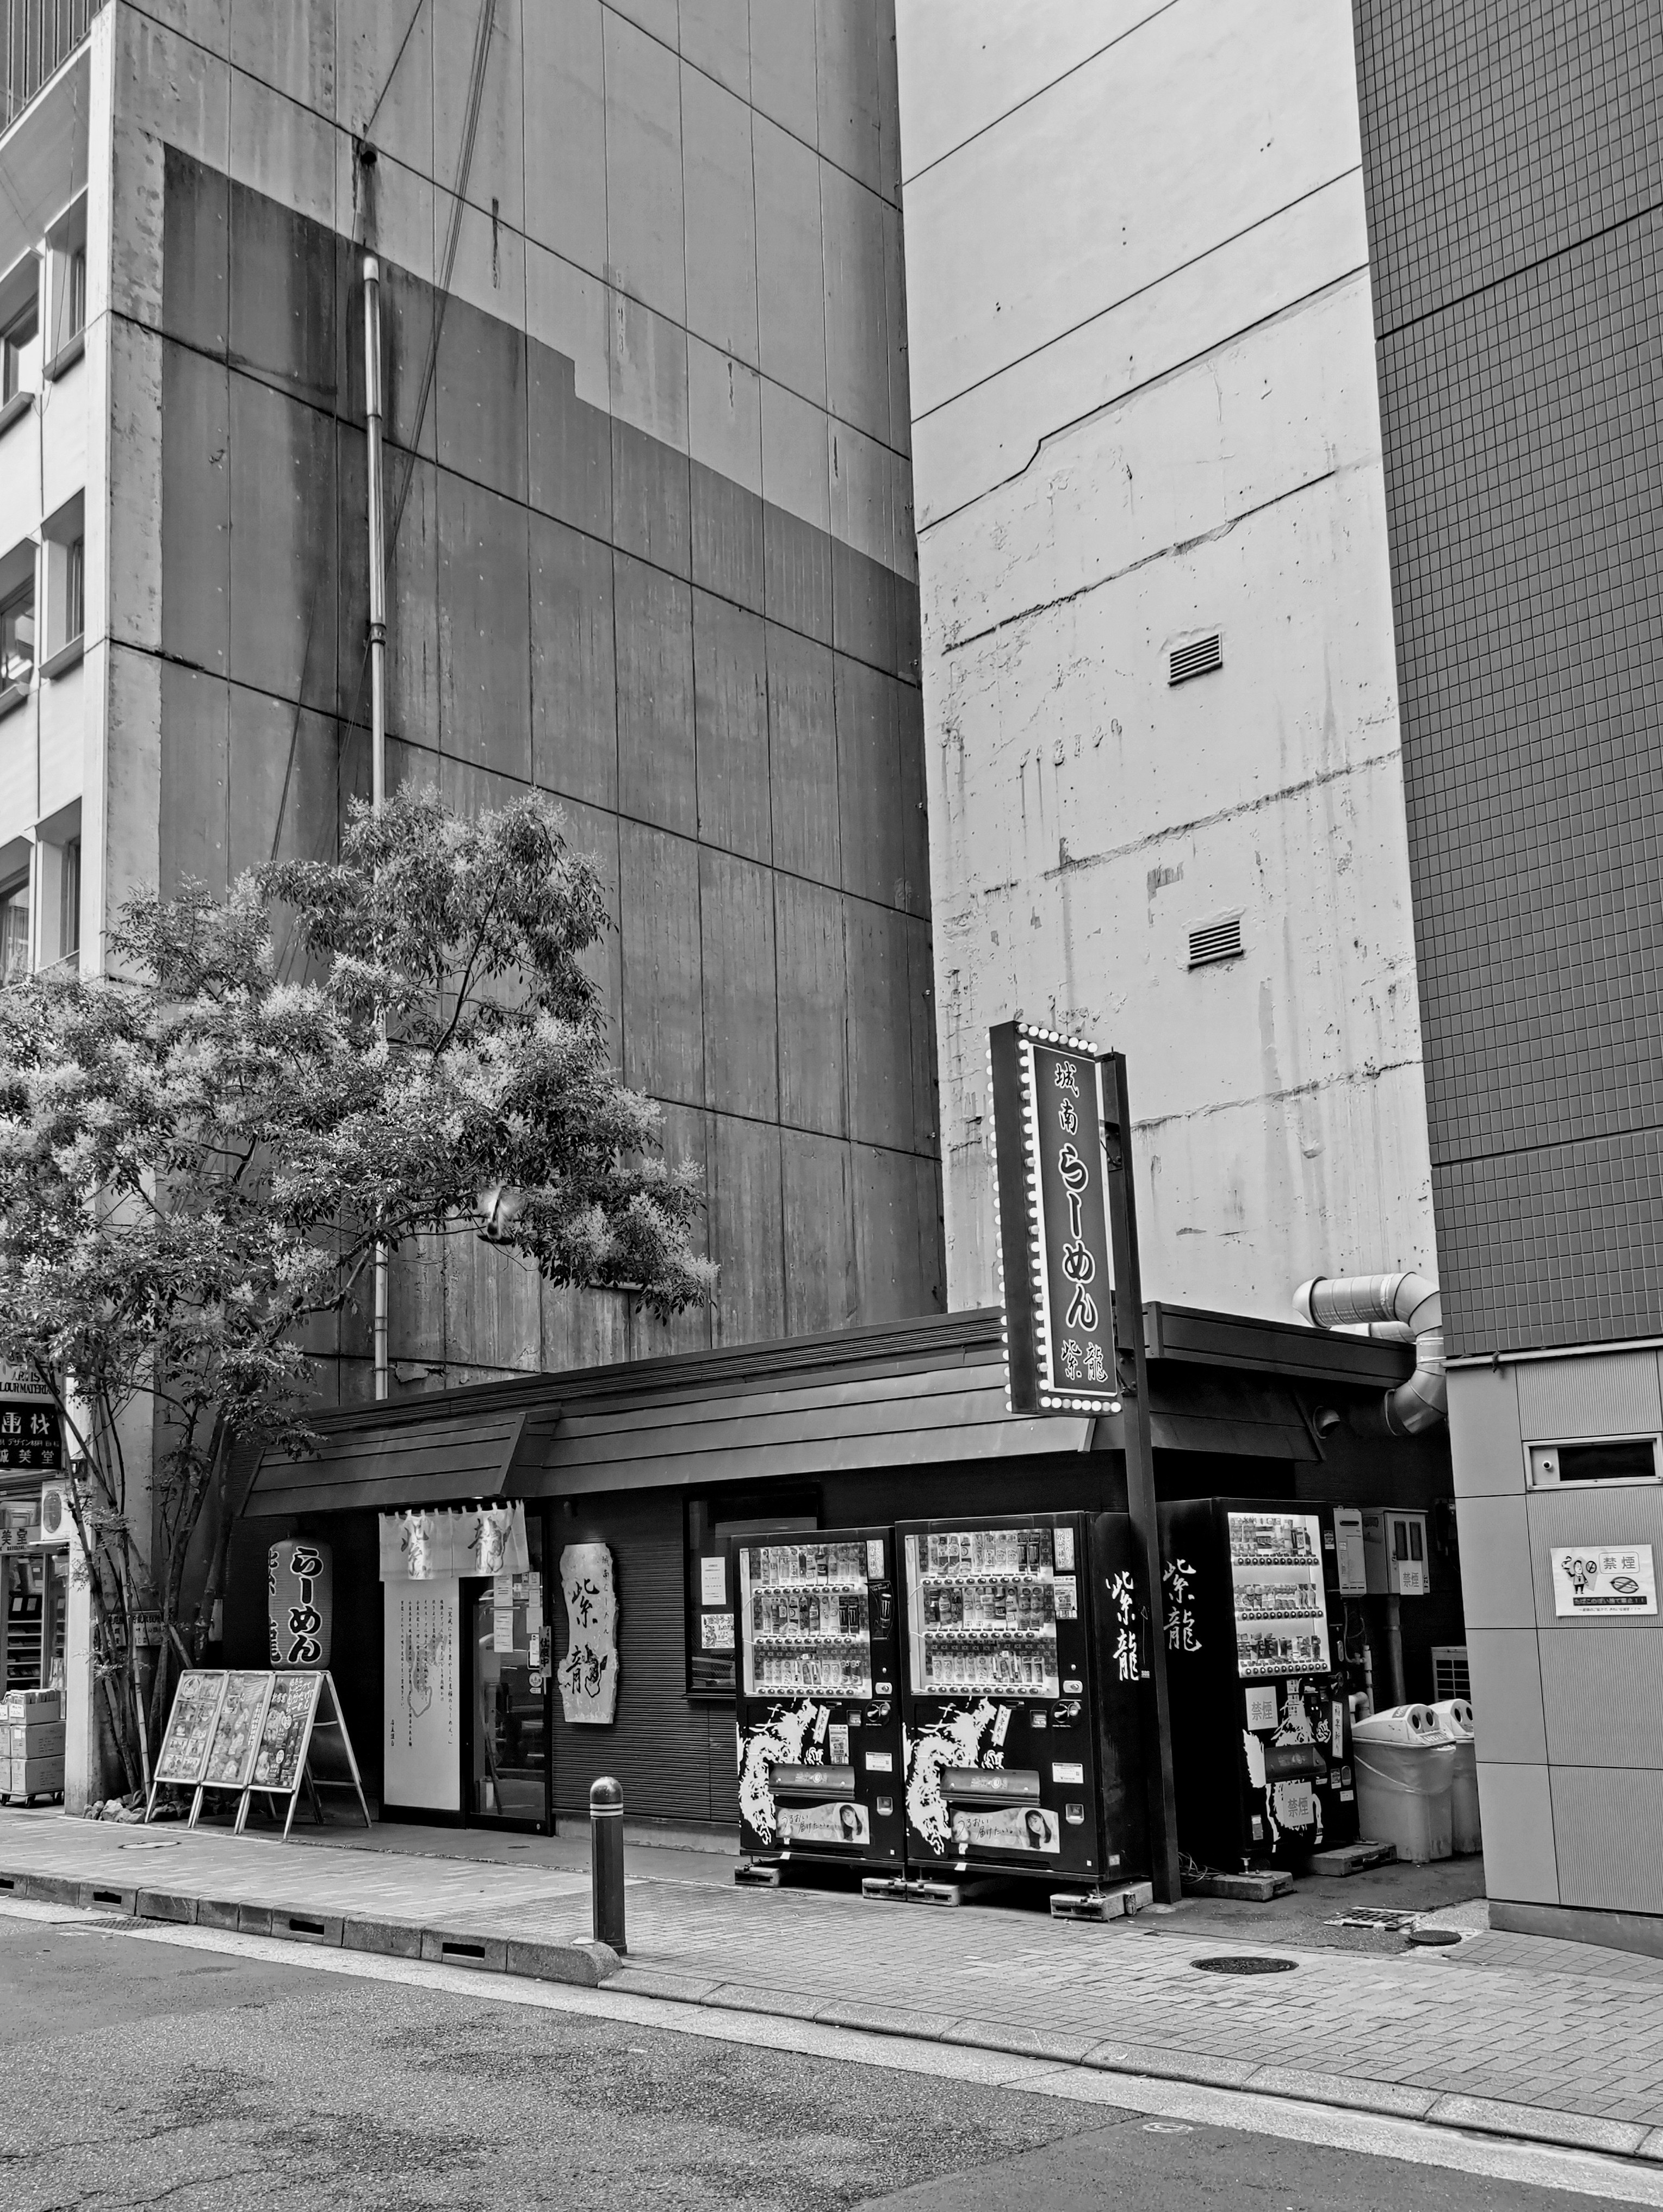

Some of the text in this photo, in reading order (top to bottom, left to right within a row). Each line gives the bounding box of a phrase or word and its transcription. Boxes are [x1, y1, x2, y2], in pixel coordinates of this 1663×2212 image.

[1062, 1340, 1108, 1381] 紫龍
[1603, 1556, 1636, 1570] 禁煙
[287, 1546, 324, 1663] らーめん
[566, 1578, 609, 1698] 紫龍
[1106, 1570, 1139, 1681] 紫龍
[1163, 1558, 1202, 1652] 紫龍
[1251, 1701, 1273, 1721] 禁煙
[1288, 1797, 1309, 1817] 禁煙
